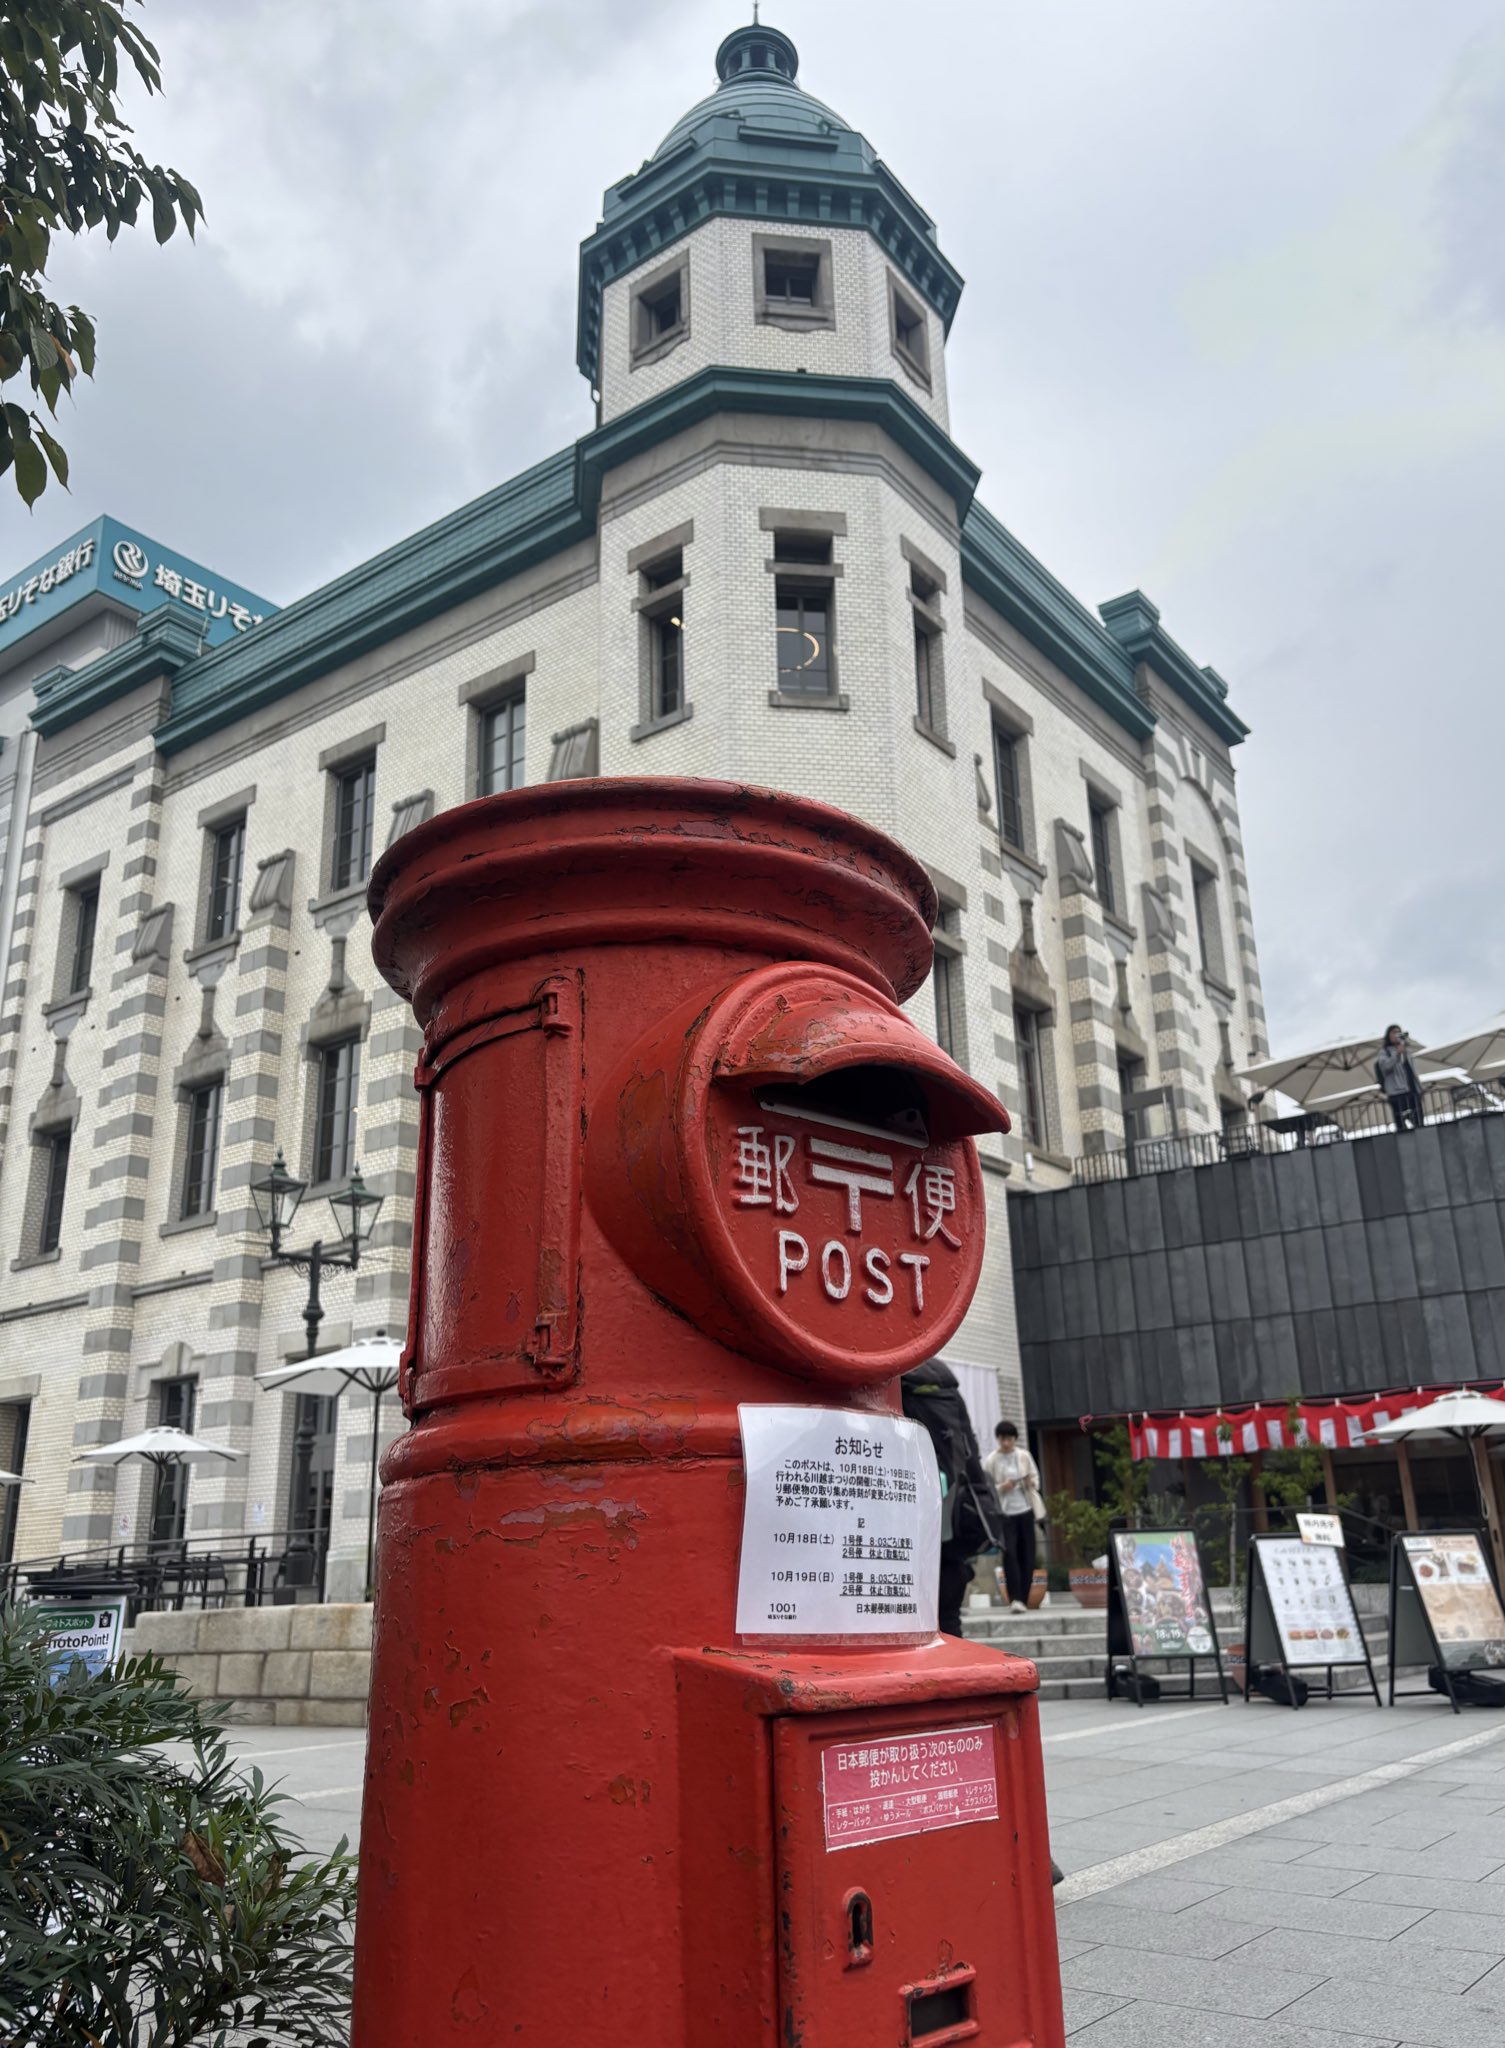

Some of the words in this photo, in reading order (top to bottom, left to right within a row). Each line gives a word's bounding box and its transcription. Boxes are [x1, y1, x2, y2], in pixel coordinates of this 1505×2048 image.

[778, 1230, 930, 1312] POST
[835, 1436, 884, 1458] お知らせ
[775, 1495, 854, 1511] 予めご了承願います。
[857, 1518, 865, 1529] 記
[773, 1532, 835, 1545] 10月18日(土)
[843, 1534, 863, 1546] 1号便
[842, 1547, 863, 1558] 2号便
[771, 1571, 835, 1583] 10月19日(日)
[843, 1572, 863, 1583] 1号便
[842, 1585, 863, 1596] 2号便
[769, 1602, 796, 1613] 1001
[47, 1633, 109, 1649] hotoPoint!
[837, 1736, 983, 1771] 日本郵便が取り扱う次のもののみ
[870, 1760, 958, 1789] 投かんしてください
